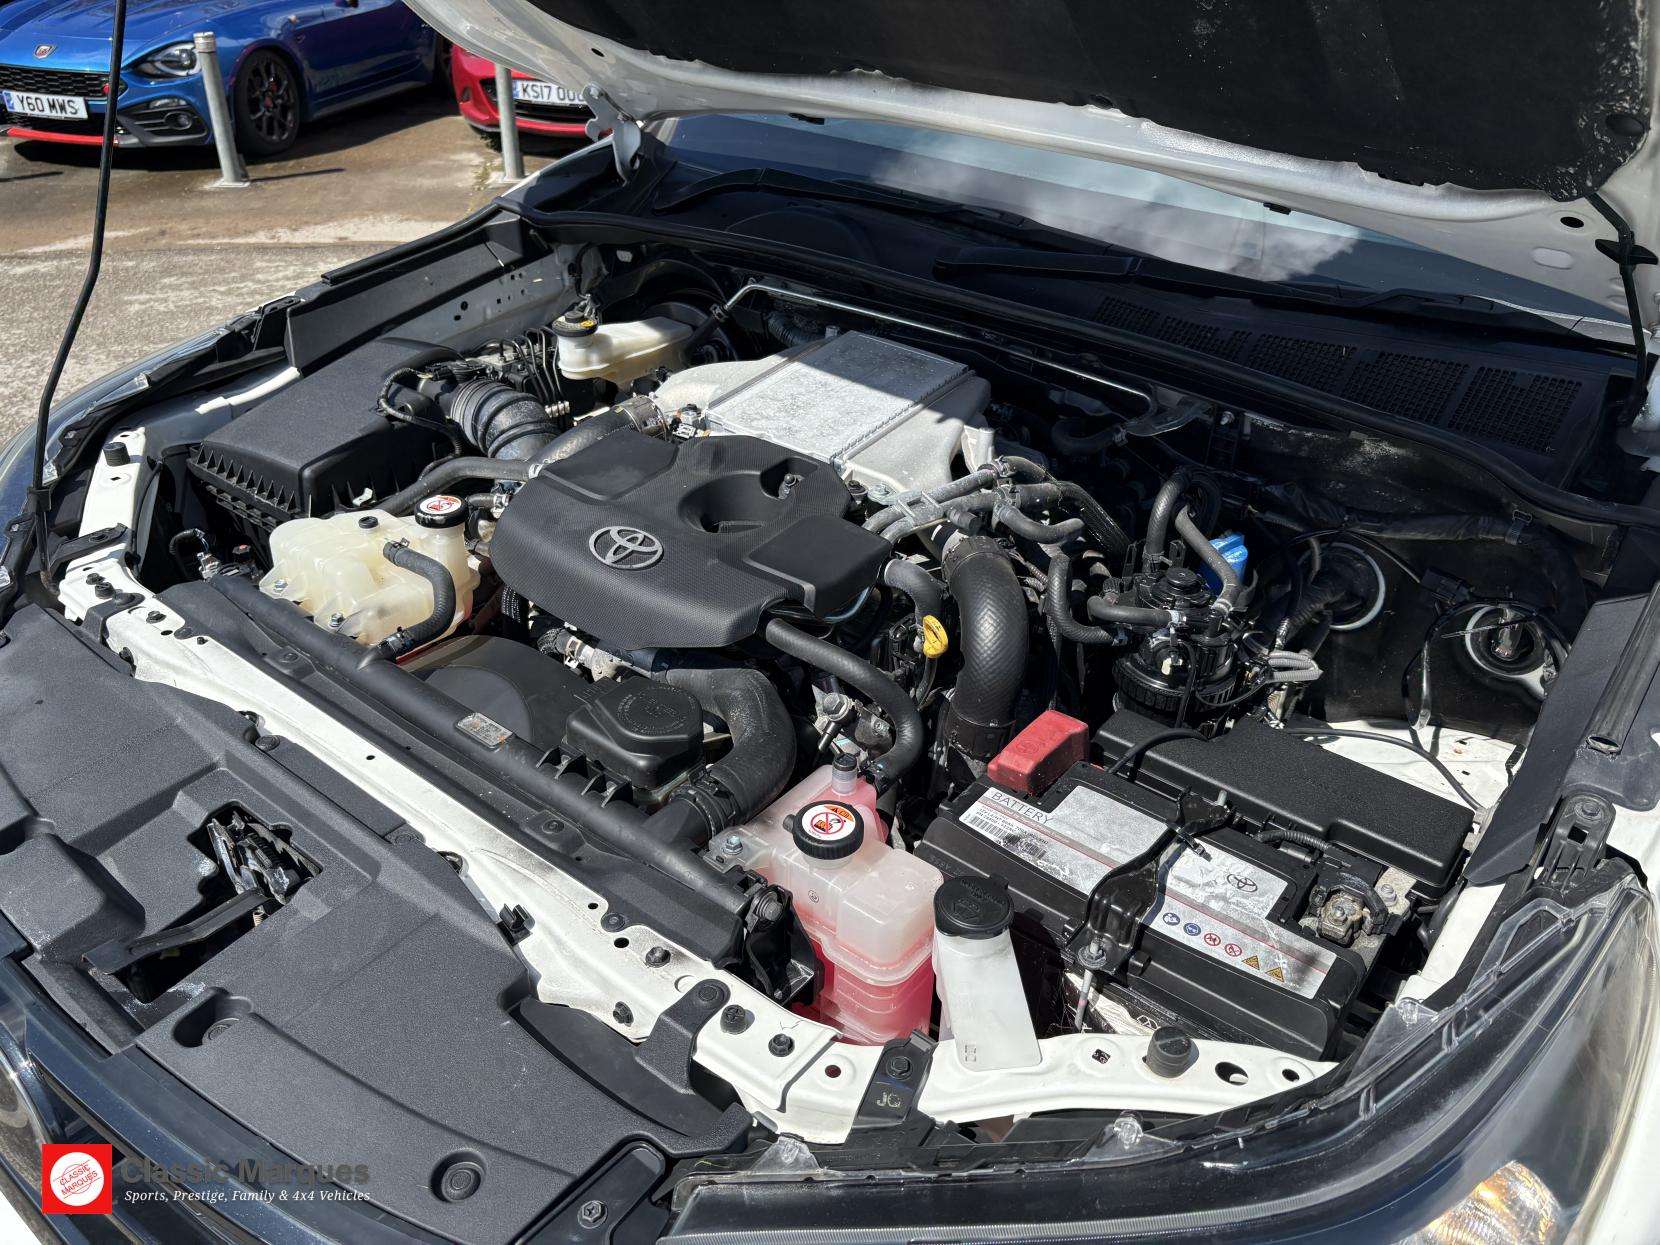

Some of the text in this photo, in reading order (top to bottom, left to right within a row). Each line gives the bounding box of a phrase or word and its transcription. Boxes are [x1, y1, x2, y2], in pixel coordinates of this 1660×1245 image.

[16, 94, 78, 115] Y60 MWS
[991, 792, 1052, 825] BATTERY
